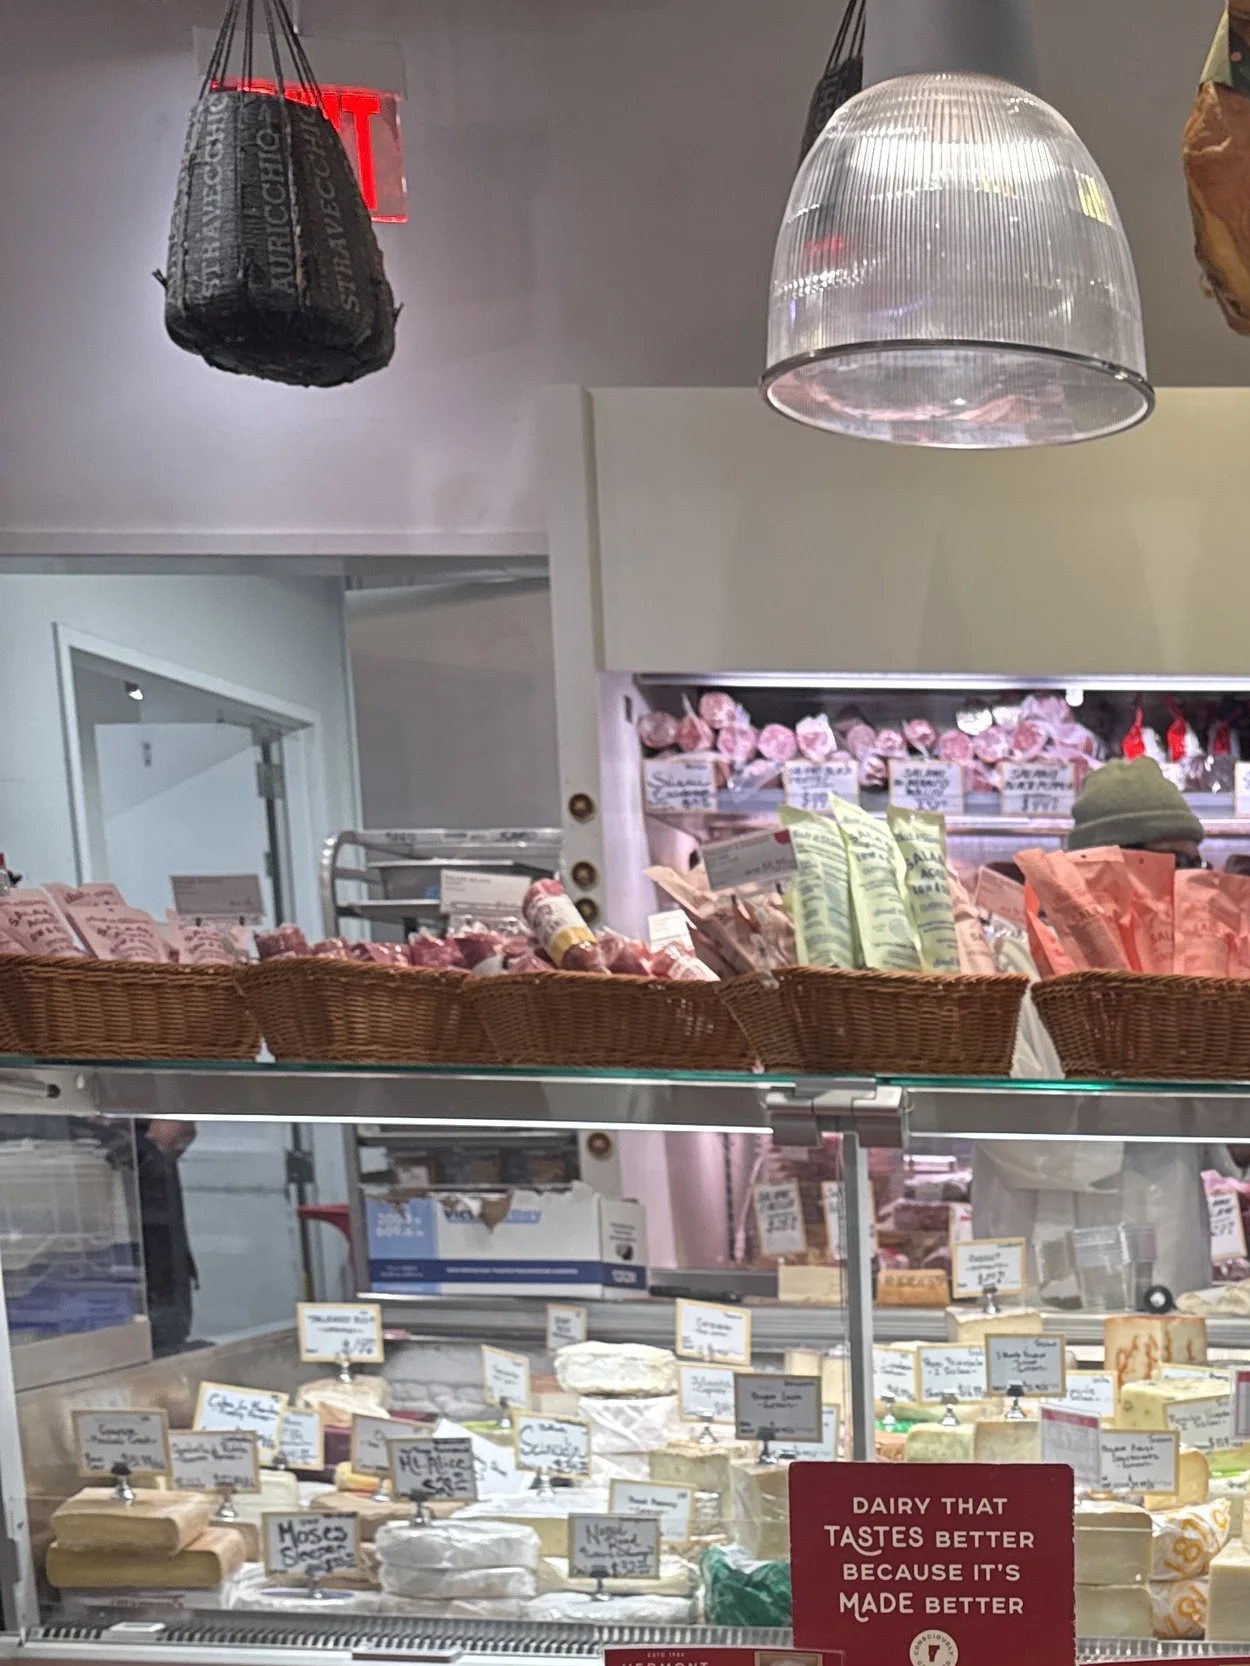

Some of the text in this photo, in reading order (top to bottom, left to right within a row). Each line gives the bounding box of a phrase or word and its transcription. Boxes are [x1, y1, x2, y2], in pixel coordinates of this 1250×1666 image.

[256, 129, 296, 295] AURICCHIO
[852, 1496, 1008, 1516] DAIRY THAT
[278, 1520, 348, 1549] Moses
[823, 1525, 1035, 1557] TASTES BETTER
[842, 1563, 1021, 1582] BECAUSE IT'S
[839, 1591, 1025, 1623] MADE BETTER
[913, 1633, 955, 1657] CONSCIOUSLY
